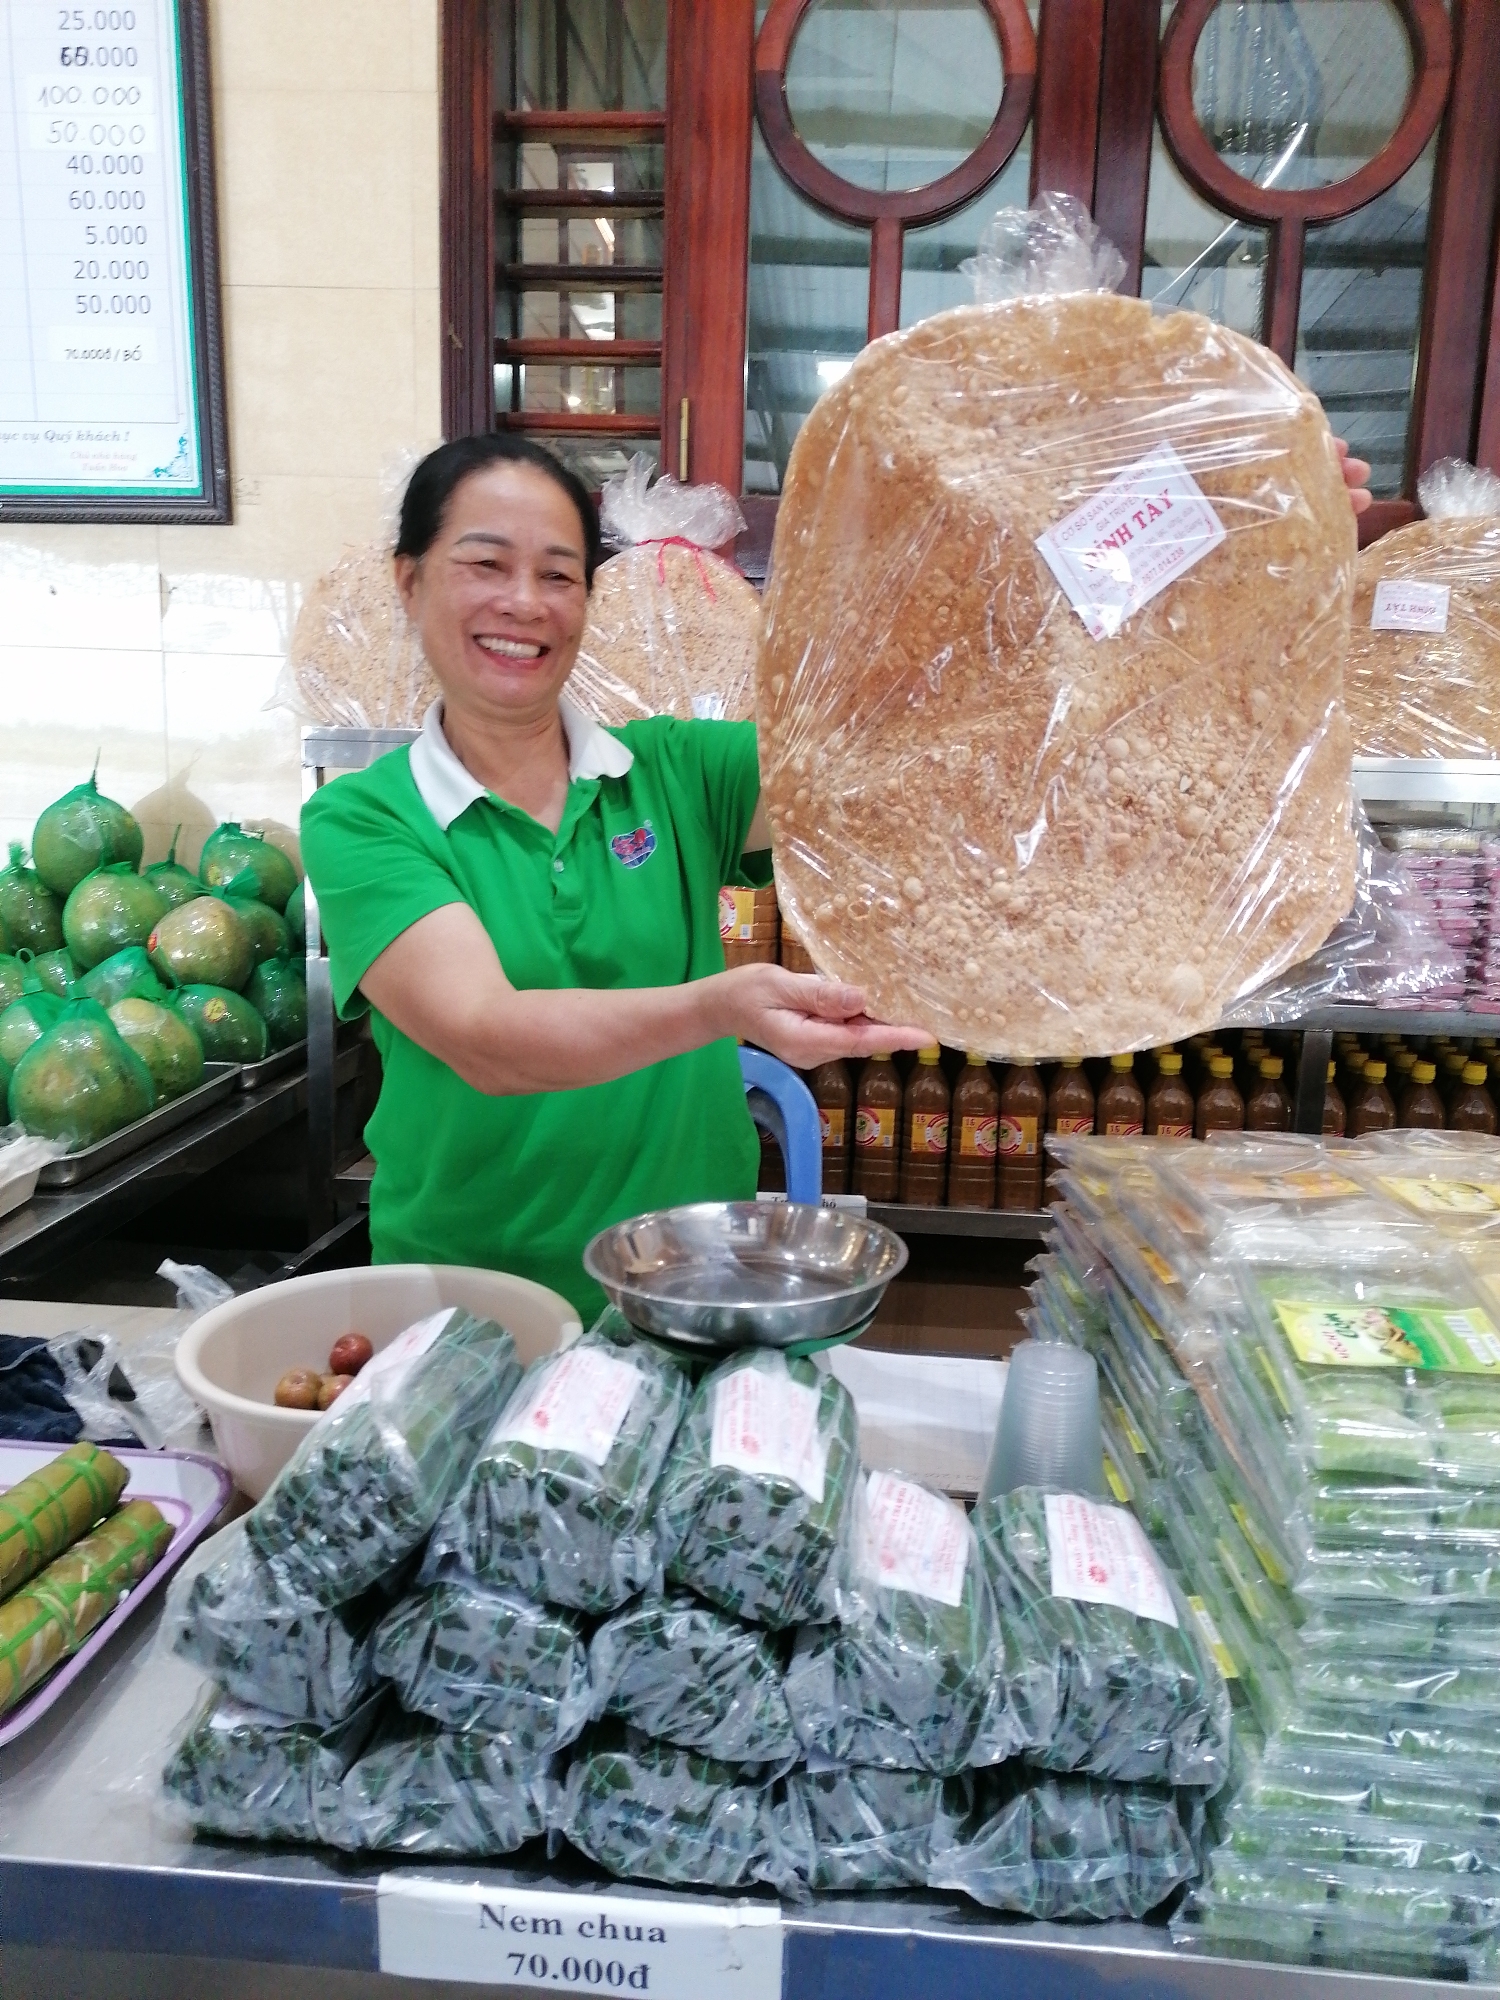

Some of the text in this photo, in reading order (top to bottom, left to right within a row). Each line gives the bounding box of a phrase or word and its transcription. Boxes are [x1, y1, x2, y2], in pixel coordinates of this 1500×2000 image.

[58, 10, 136, 31] 25.000
[66, 154, 144, 175] 40.000
[68, 190, 146, 210] 60.000
[85, 225, 148, 245] 5.000
[73, 260, 149, 280] 20.000
[75, 294, 152, 314] 50.000
[76, 430, 120, 442] khách
[1132, 489, 1173, 530] TÂY
[1096, 516, 1110, 532] GIA
[478, 1903, 668, 1943] Nem chua
[506, 1952, 650, 1990] 70.000đ
